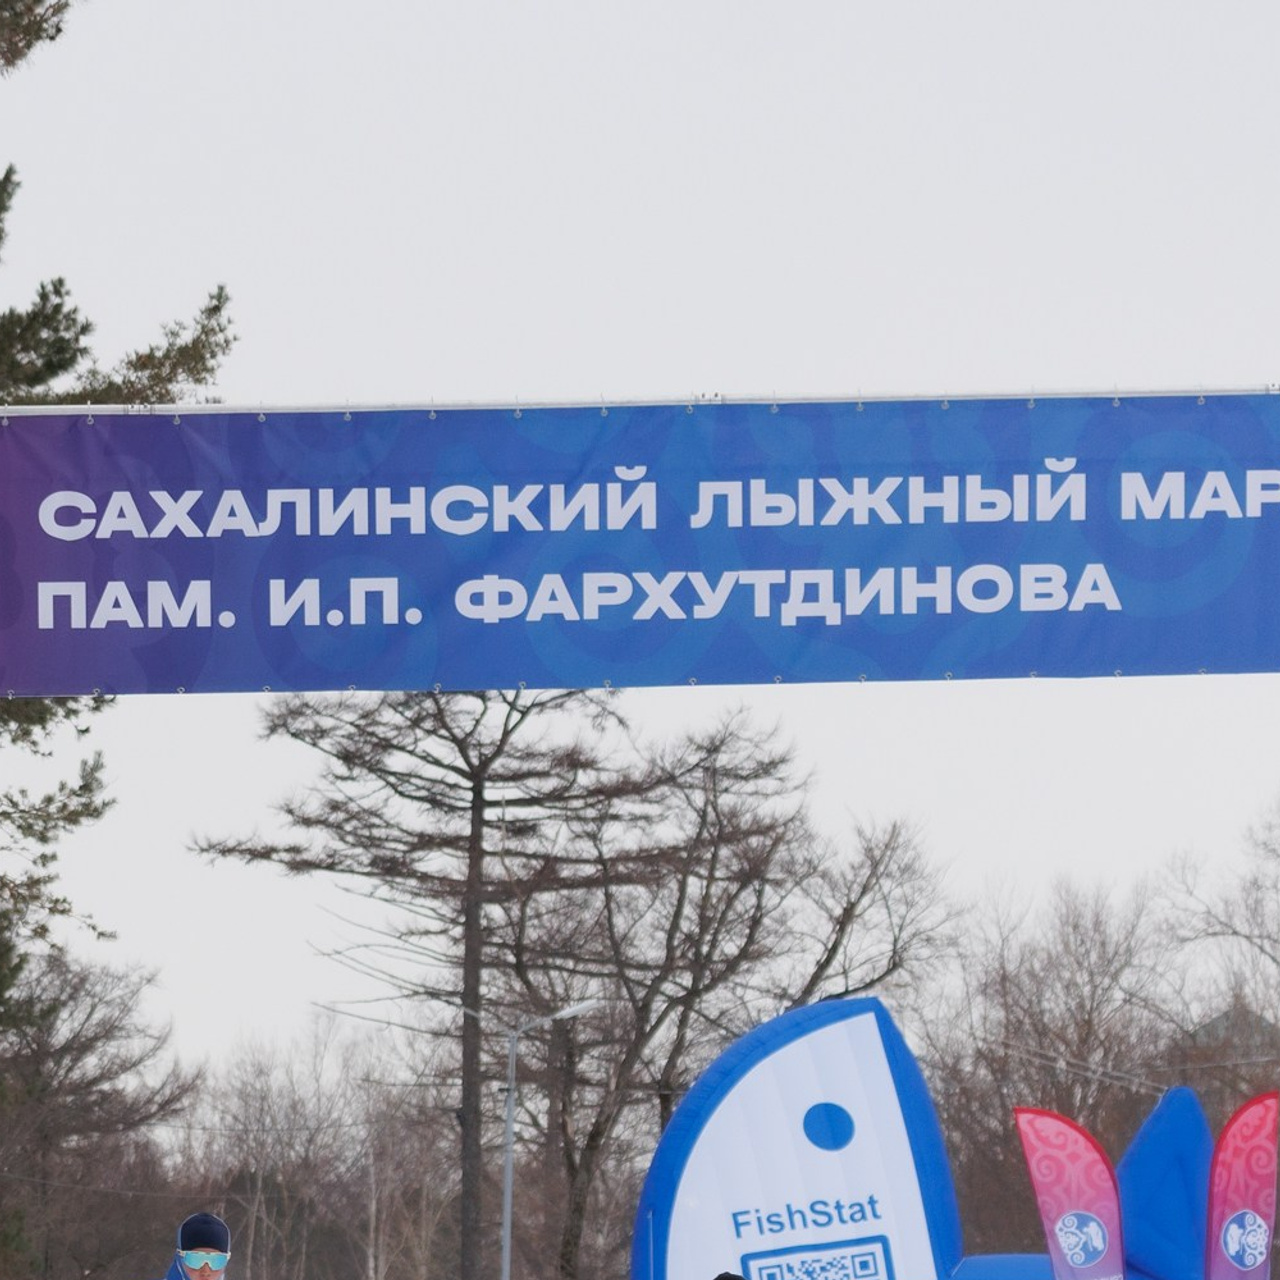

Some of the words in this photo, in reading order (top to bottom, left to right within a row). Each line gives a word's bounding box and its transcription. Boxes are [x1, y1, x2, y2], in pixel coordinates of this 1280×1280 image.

[38, 465, 658, 542] САХАЛИНСКИЙ
[690, 457, 1087, 529] ЛЫЖНЫЙ
[37, 580, 237, 630] ПАМ.
[269, 577, 423, 627] И.П.
[454, 563, 1123, 626] ФАРХУТДИНОВА
[731, 1194, 882, 1239] FishStat
